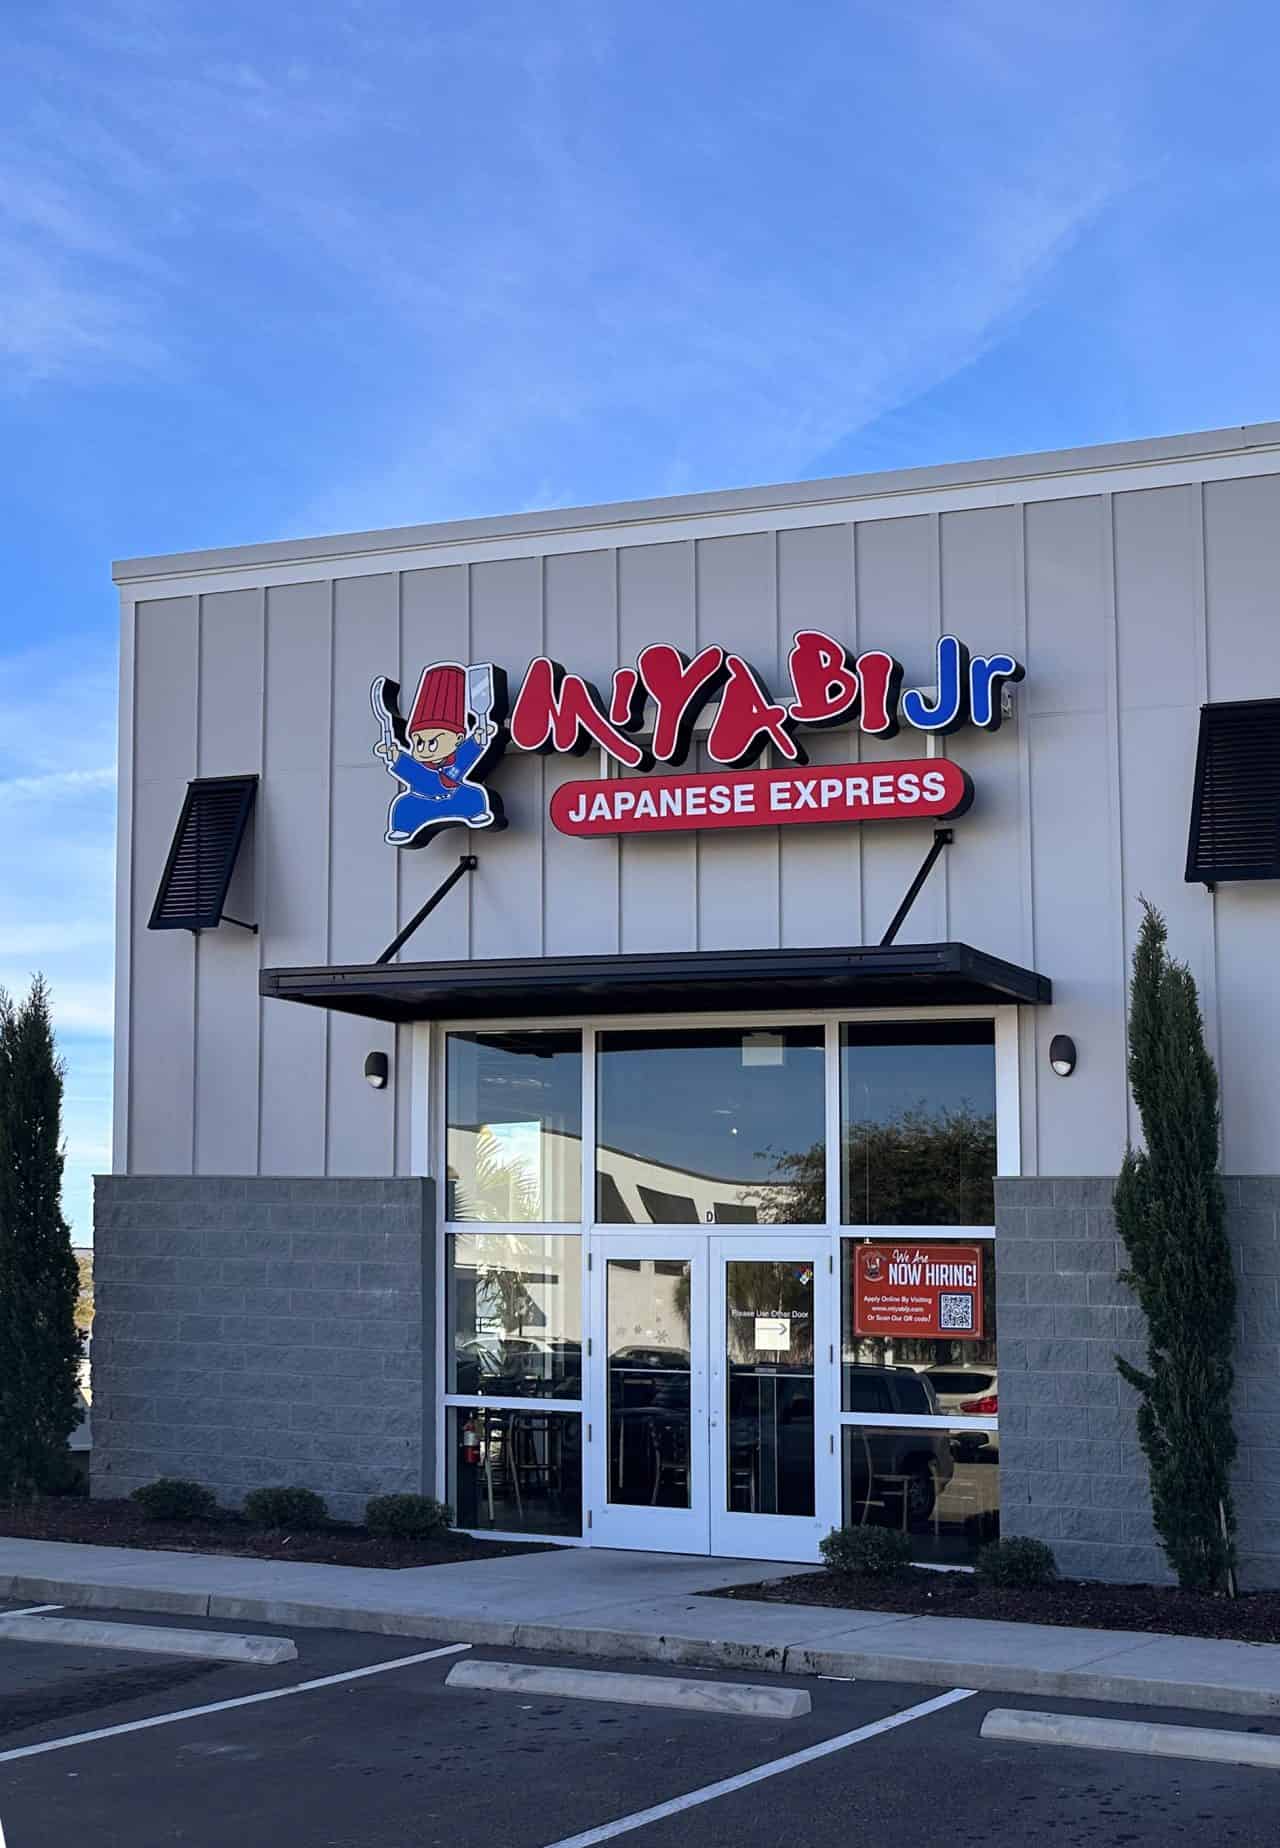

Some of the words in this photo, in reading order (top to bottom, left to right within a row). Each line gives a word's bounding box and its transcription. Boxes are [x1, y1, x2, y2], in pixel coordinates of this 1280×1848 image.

[510, 628, 894, 769] MIYABI
[902, 634, 1016, 730] Jr
[568, 783, 755, 822] JAPANESE
[769, 771, 946, 811] EXPRESS
[892, 1249, 909, 1263] We
[911, 1249, 928, 1264] Are
[888, 1263, 922, 1286] NOW
[925, 1264, 977, 1287] HIRING!
[731, 1309, 754, 1318] Please
[792, 1311, 808, 1319] Door
